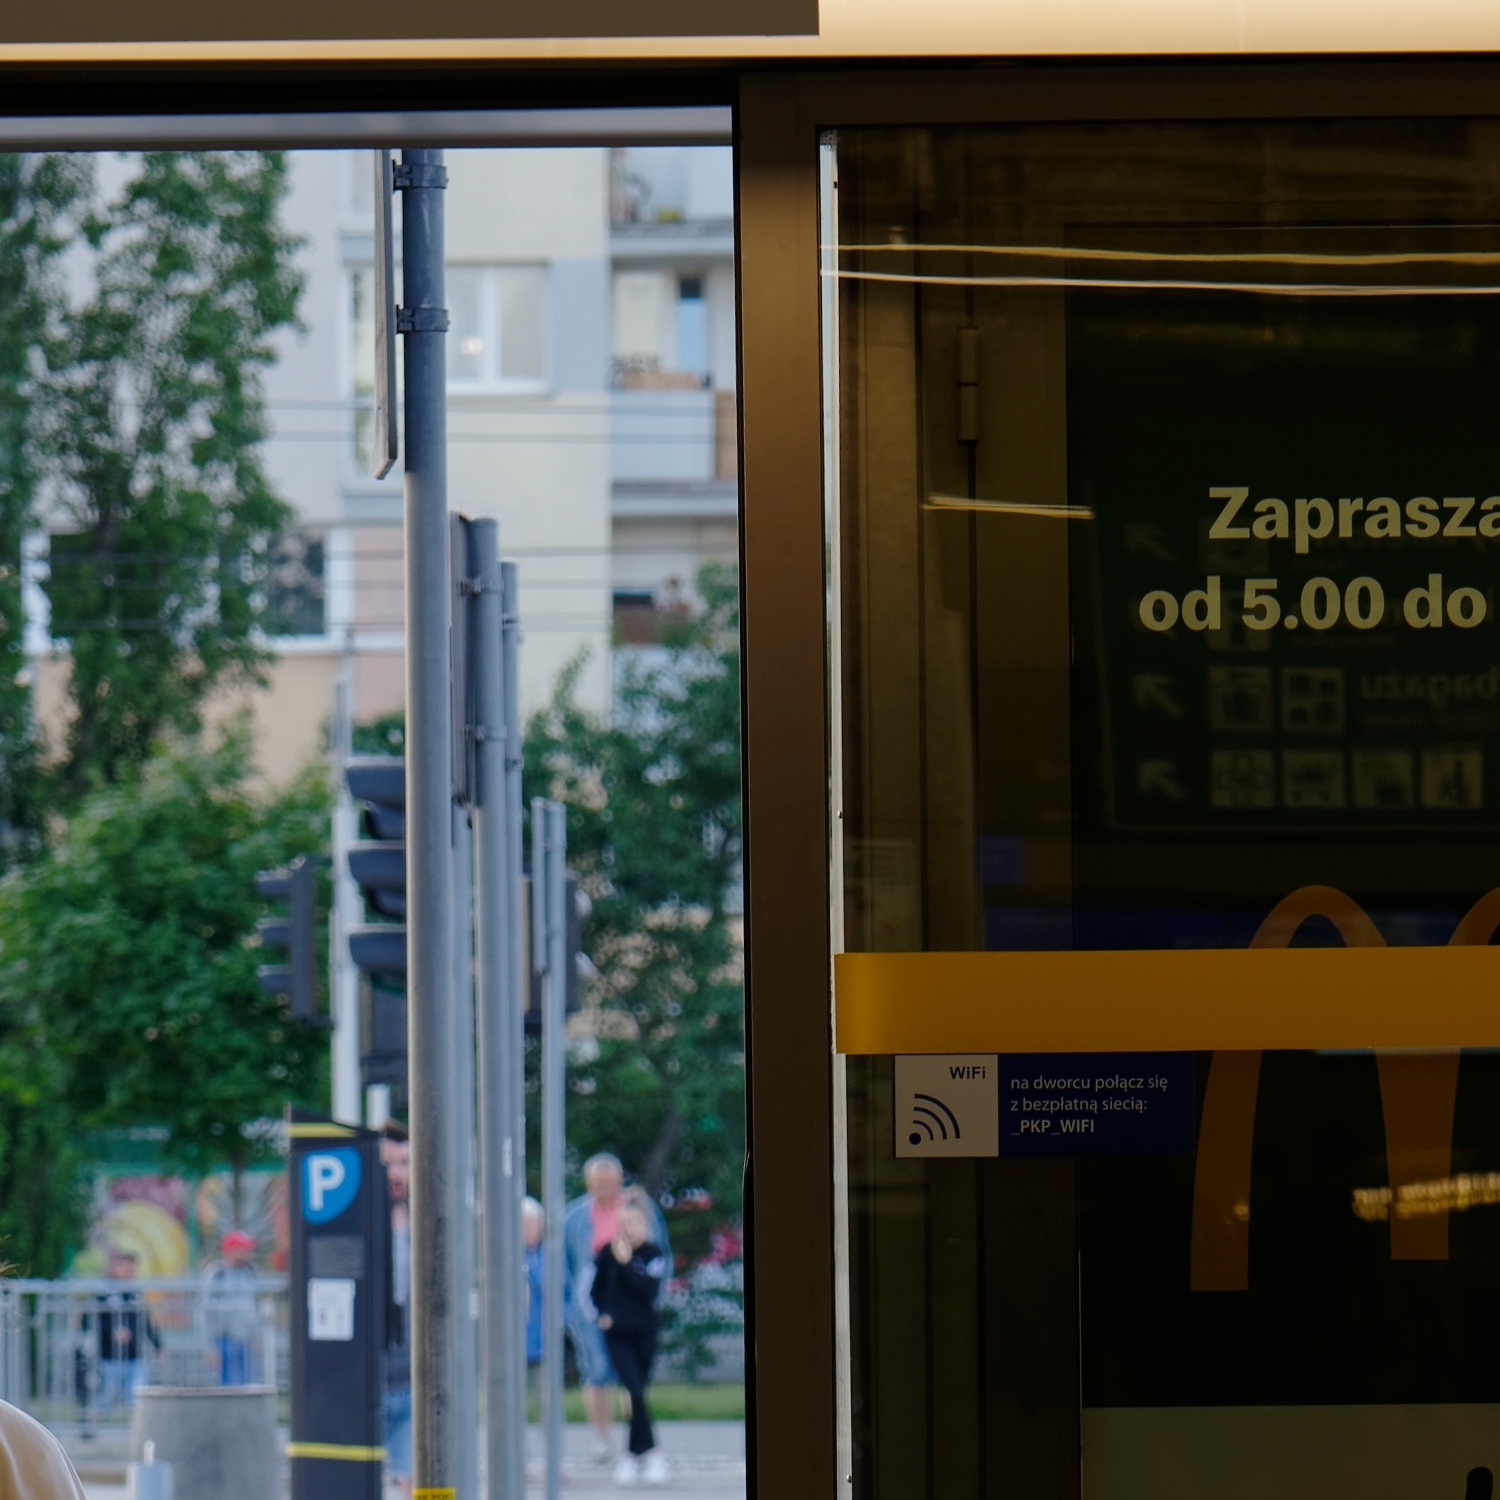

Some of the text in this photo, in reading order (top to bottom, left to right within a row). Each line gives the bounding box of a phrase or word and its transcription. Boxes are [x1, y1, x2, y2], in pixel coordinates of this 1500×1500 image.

[1138, 576, 1221, 631] od
[1241, 576, 1385, 630] 5.00
[1403, 573, 1487, 627] do
[950, 1066, 986, 1079] WiFi
[1011, 1075, 1168, 1092] na dworcu połącz się
[1011, 1097, 1148, 1114] z bezpłatną siecią:
[1011, 1119, 1095, 1136] _PKP_WIFI
[307, 1154, 346, 1211] P
